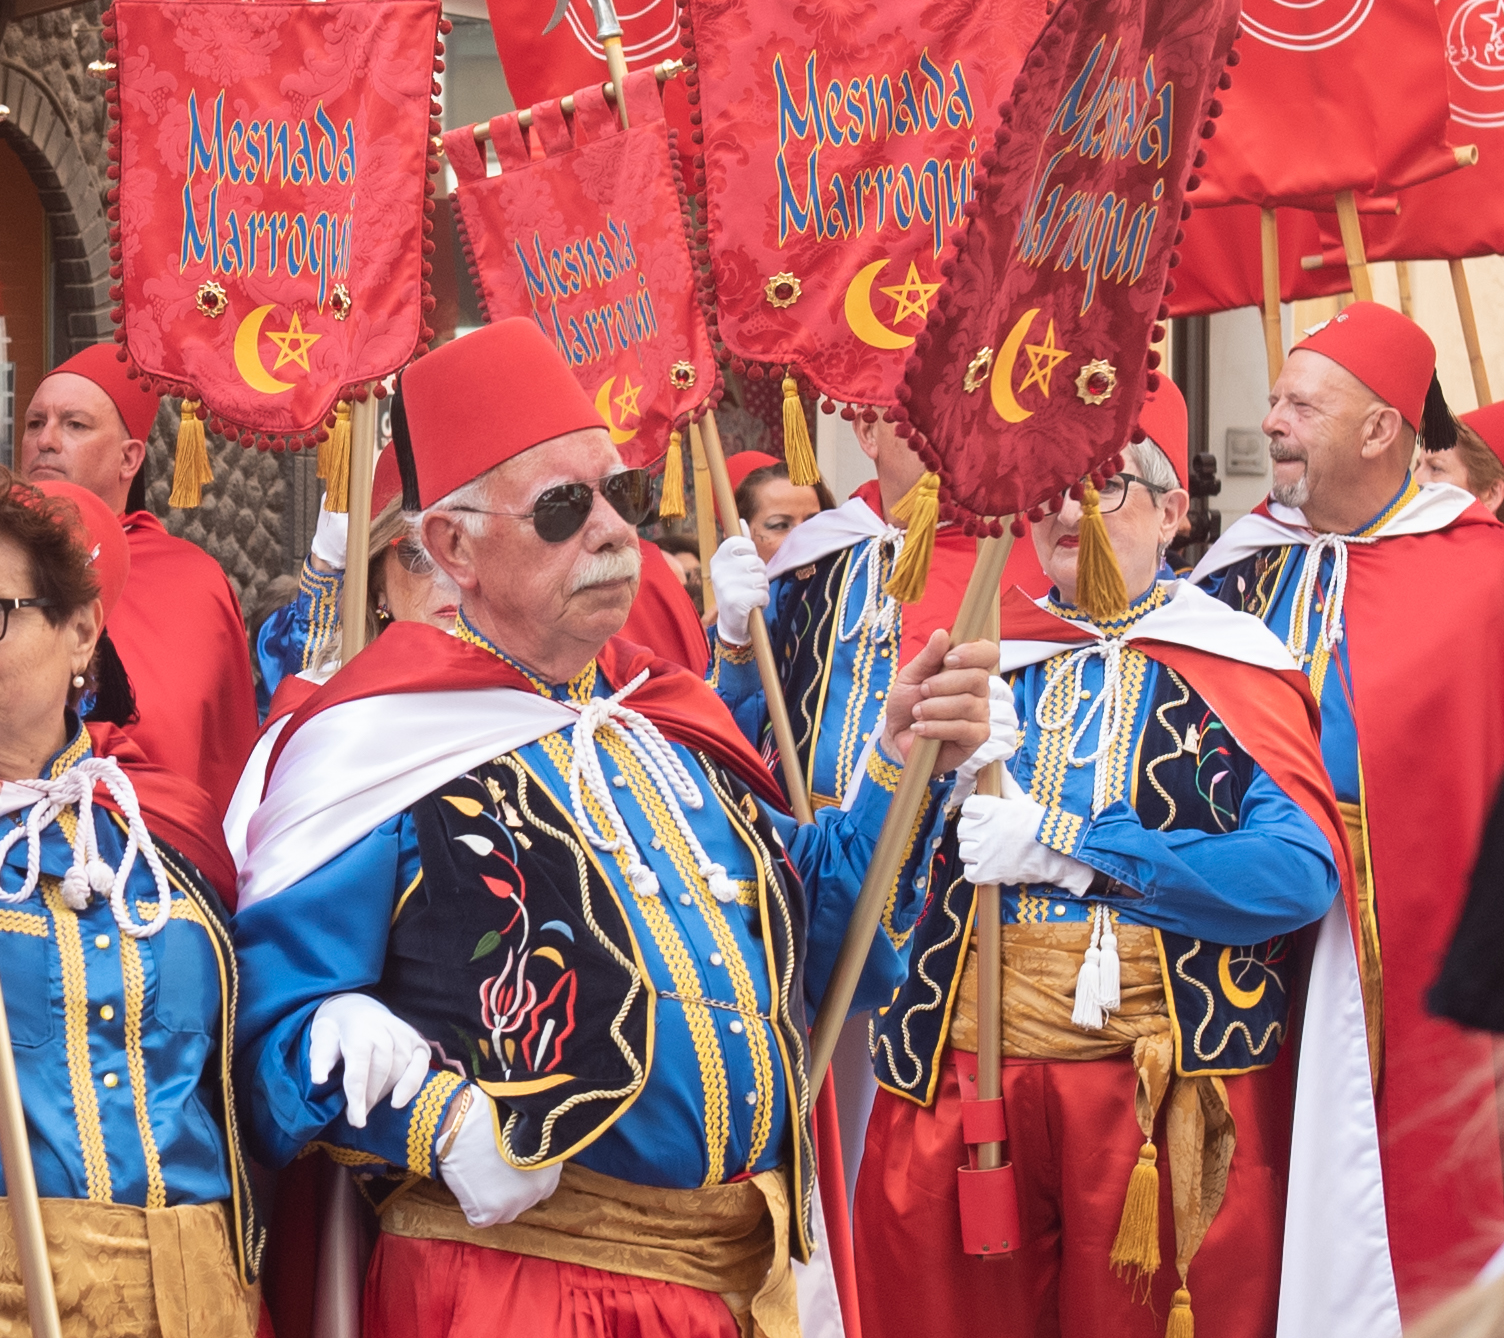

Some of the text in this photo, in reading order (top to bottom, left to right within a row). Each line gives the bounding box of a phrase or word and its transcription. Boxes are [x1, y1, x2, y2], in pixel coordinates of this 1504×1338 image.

[188, 88, 356, 186] Mesnada
[772, 46, 975, 151] Mesnada
[179, 176, 356, 314] Marroqui
[775, 135, 977, 261] Marroqui
